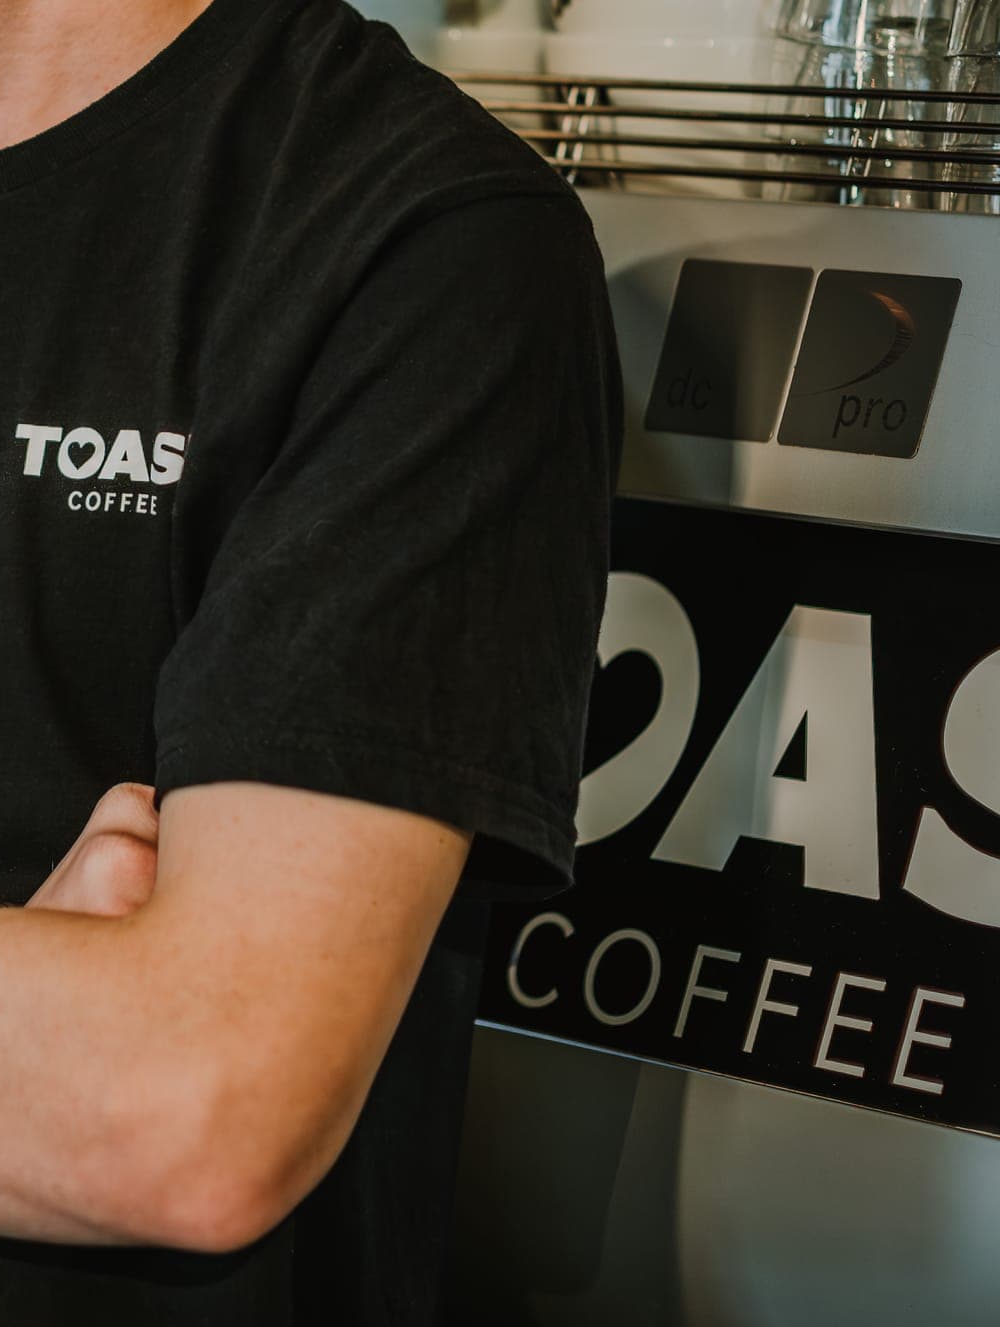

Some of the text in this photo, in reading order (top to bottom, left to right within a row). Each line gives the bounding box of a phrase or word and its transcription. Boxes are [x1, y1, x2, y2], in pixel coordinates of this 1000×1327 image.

[832, 393, 907, 439] pro
[15, 423, 192, 486] TOAS
[67, 490, 158, 516] COFFEE
[508, 912, 966, 1095] COFFEE
